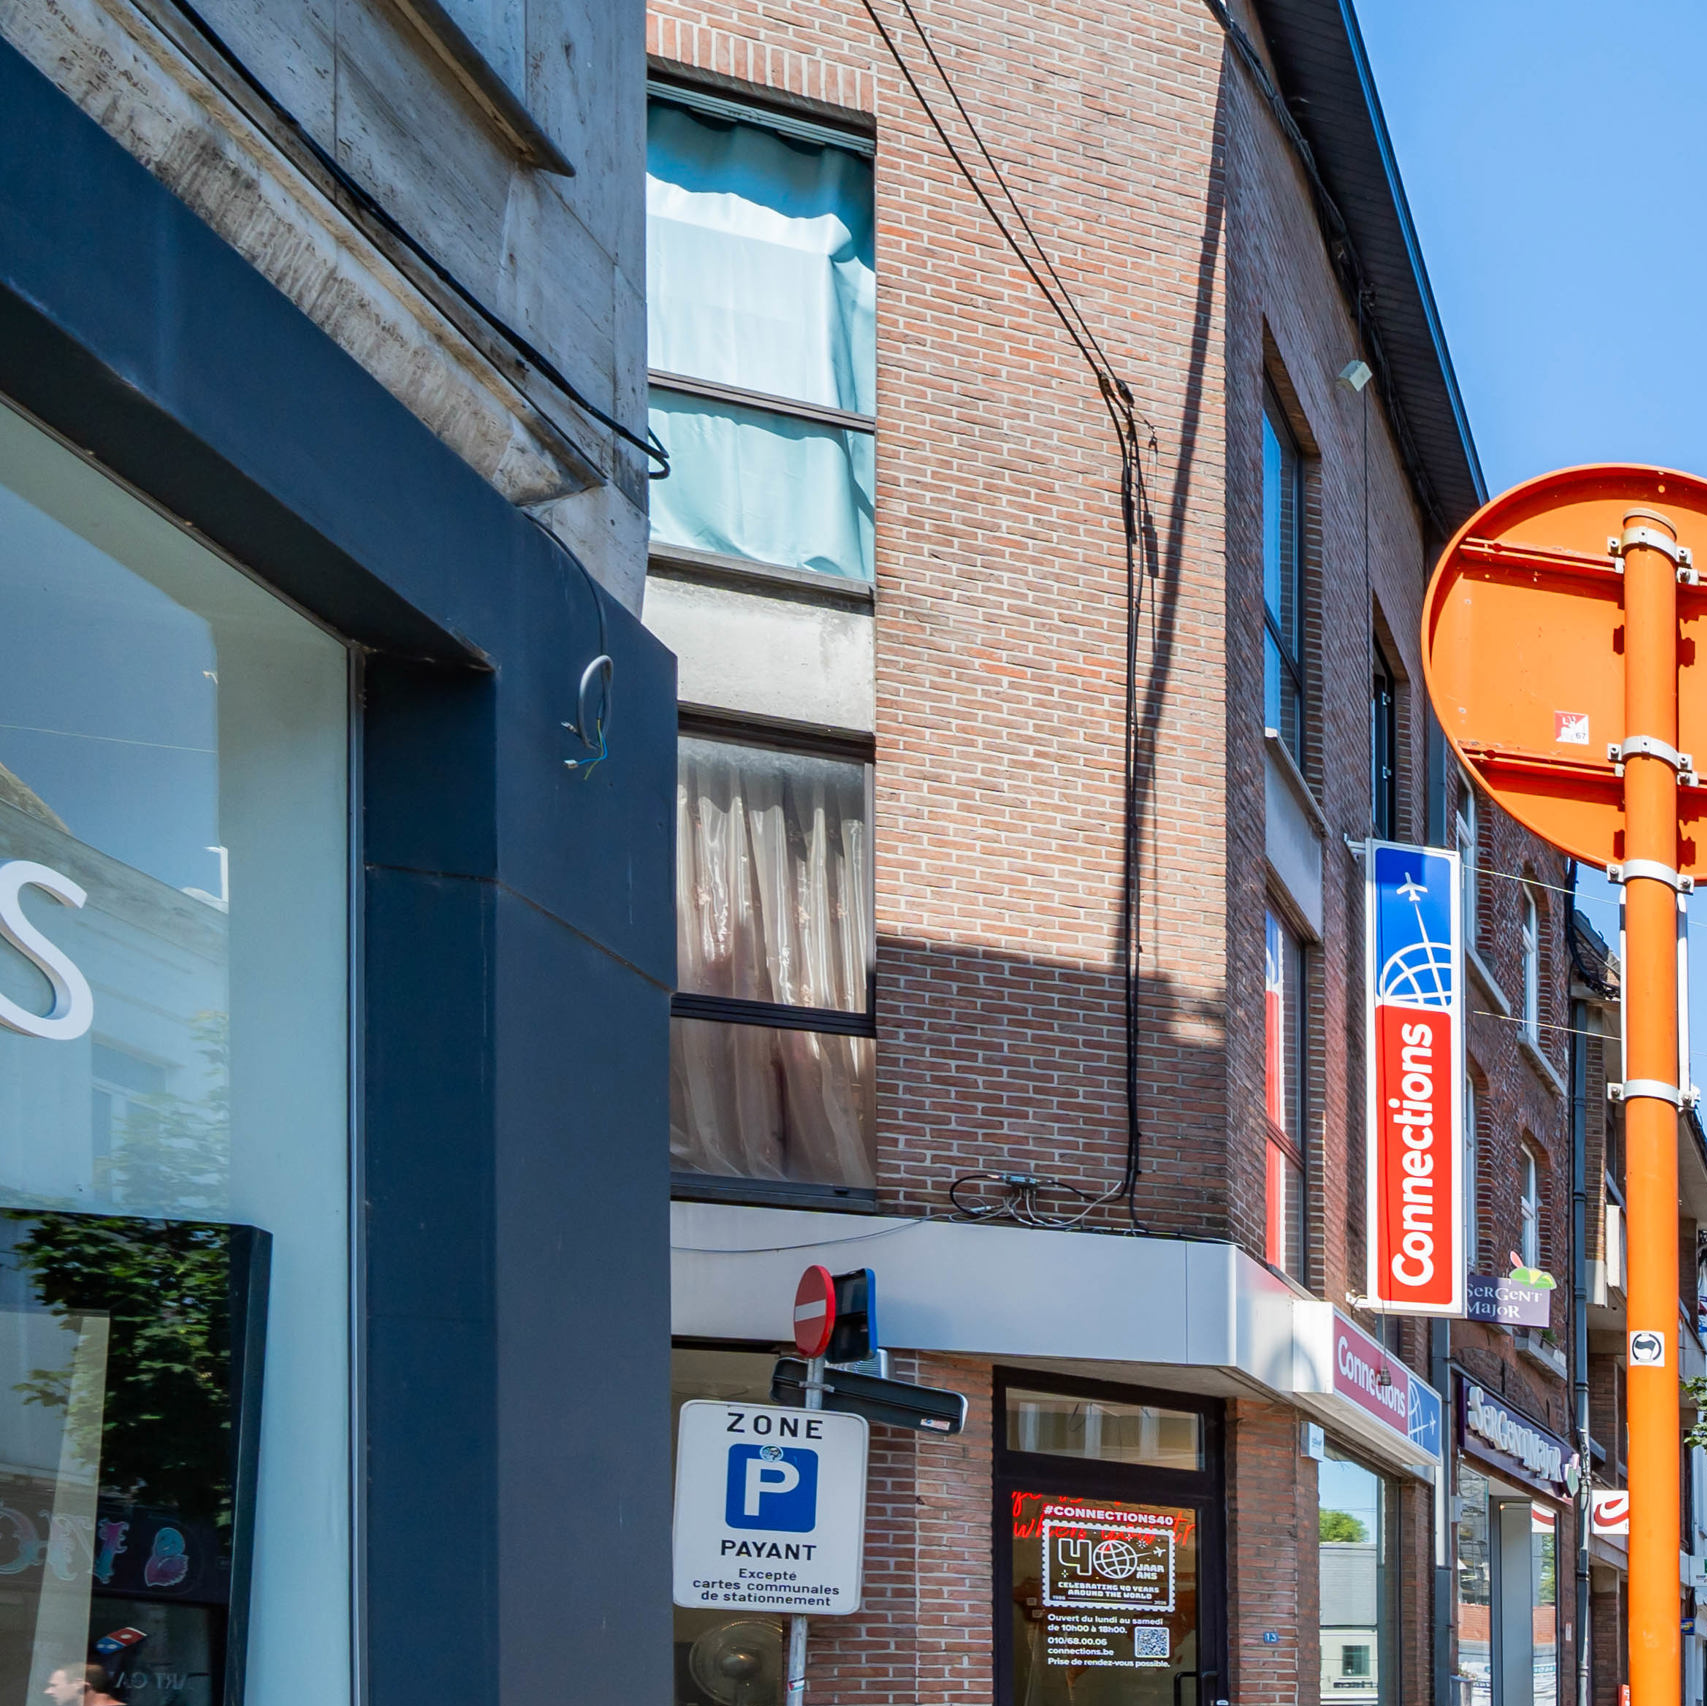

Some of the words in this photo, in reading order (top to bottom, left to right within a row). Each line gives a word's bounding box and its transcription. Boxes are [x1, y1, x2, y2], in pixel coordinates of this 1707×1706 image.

[1390, 1022, 1434, 1286] Connections
[727, 1412, 823, 1440] ZONE
[744, 1457, 800, 1516] P
[1044, 1505, 1174, 1526] #CONNECTIONS40
[720, 1539, 817, 1561] PAYANT
[738, 1568, 797, 1583] Excepté
[1136, 1564, 1165, 1573] JAAR
[693, 1579, 741, 1590] cartes
[747, 1582, 840, 1595] communales
[1058, 1581, 1118, 1591] CELEBRATING
[1132, 1584, 1160, 1593] YEARS
[1068, 1588, 1104, 1597] AROUND
[1105, 1590, 1122, 1598] THE
[1123, 1591, 1152, 1600] WORLD
[701, 1590, 718, 1601] de
[723, 1591, 831, 1606] stationnement
[1047, 1614, 1079, 1622] Ouvert
[1095, 1616, 1117, 1624] lundi
[1061, 1624, 1089, 1632] 10h00
[1098, 1626, 1128, 1634] 18h00.
[1047, 1647, 1115, 1656] connections.be
[1071, 1658, 1083, 1666] de
[1135, 1660, 1171, 1668] possible.
